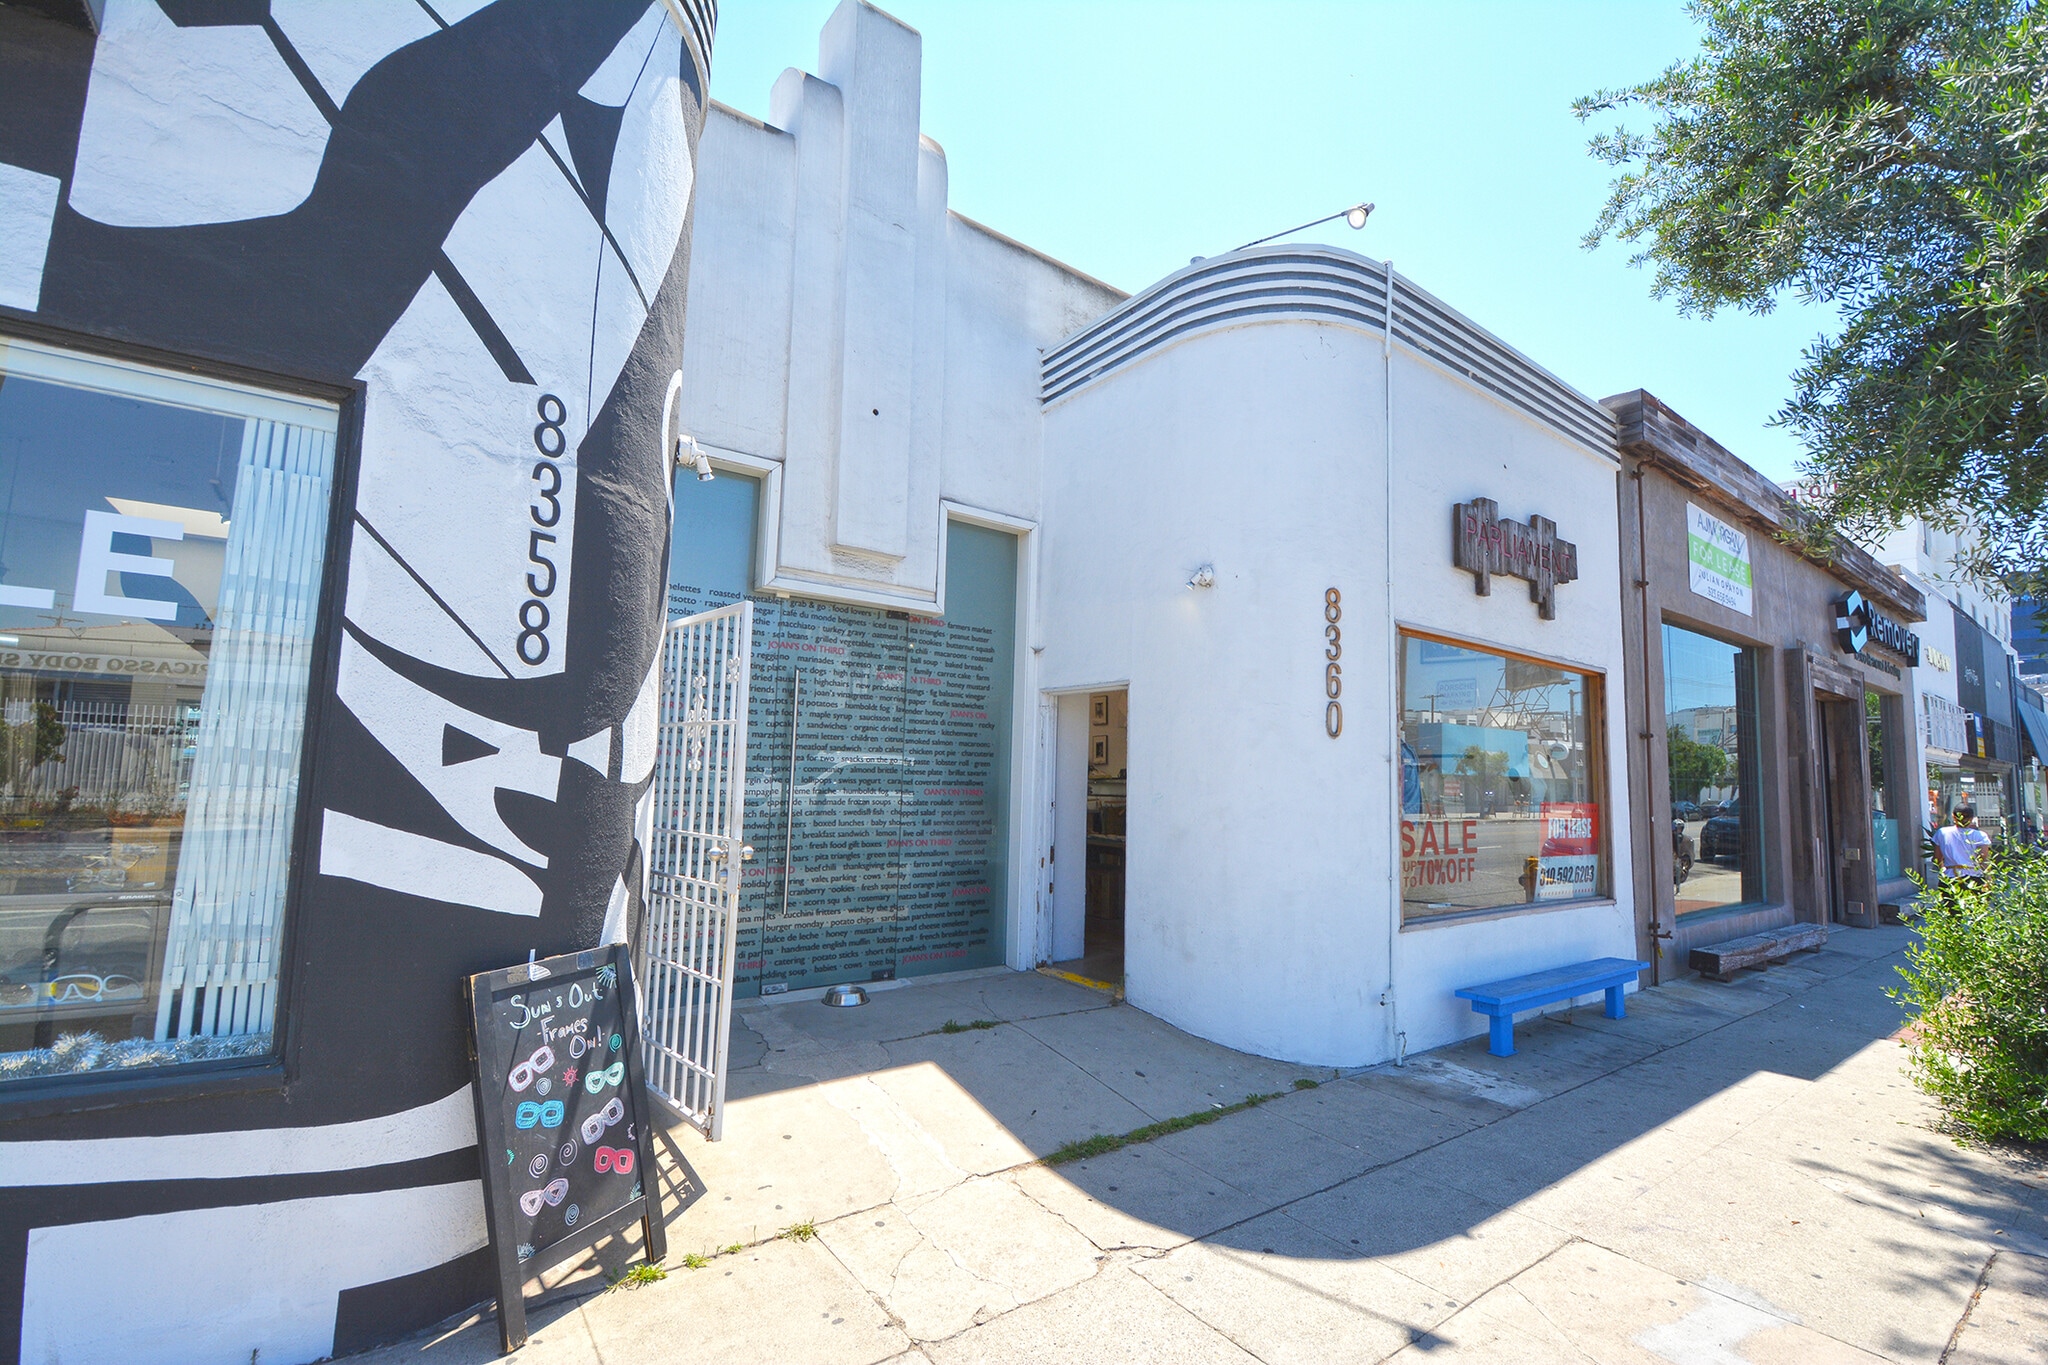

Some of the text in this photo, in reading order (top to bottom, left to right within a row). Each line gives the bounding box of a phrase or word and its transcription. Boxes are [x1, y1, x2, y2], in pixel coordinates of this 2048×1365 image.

[516, 393, 567, 667] 8358
[1466, 516, 1571, 576] PARLIAMENT
[1693, 541, 1747, 582] FOR LEASE
[669, 596, 696, 605] risotto
[709, 589, 740, 600] roasted
[832, 605, 849, 613] food
[850, 607, 872, 616] lovers
[811, 614, 837, 622] monde
[838, 617, 866, 627] beignets
[778, 620, 816, 630] macchiato
[822, 625, 846, 636] turkey
[848, 629, 865, 638] gravy
[788, 631, 874, 648] beans grilled vegetables
[820, 645, 844, 655] THIRD
[797, 655, 834, 664] marinades
[841, 660, 871, 669] espresso
[1325, 587, 1343, 739] 8360
[810, 666, 826, 675] dogs
[833, 669, 848, 678] high
[850, 671, 870, 679] chairs
[752, 674, 772, 682] dried
[814, 677, 849, 688] highchairs
[750, 684, 774, 693] friends
[814, 689, 835, 697] joan's
[837, 692, 873, 701] vinaigrette
[806, 701, 838, 710] potatoes
[845, 702, 878, 710] humboldt
[810, 711, 830, 721] maple
[833, 713, 852, 721] syrup
[807, 721, 847, 730] sandwiches
[821, 733, 844, 741] letters
[851, 734, 878, 742] children
[830, 744, 861, 752] sandwich
[752, 753, 790, 762] afternoon
[806, 753, 816, 761] for
[803, 766, 843, 774] community
[801, 777, 832, 785] lollipops
[802, 831, 835, 839] breakfast
[838, 830, 869, 838] sandwich
[1548, 818, 1592, 839] FOR LEASE
[1401, 820, 1478, 858] SALE
[793, 854, 808, 862] bars
[815, 854, 828, 862] pita
[831, 853, 860, 862] triangles
[805, 864, 821, 872] beef
[822, 863, 836, 871] chili
[1403, 861, 1416, 872] UP
[831, 874, 856, 884] parking
[1403, 876, 1417, 888] TO
[789, 888, 825, 896] cranberry
[804, 898, 825, 906] acorn
[784, 906, 874, 919] zucchini fritters by
[766, 916, 874, 932] burger monday potato chips
[799, 932, 819, 940] leche
[826, 930, 848, 938] honey
[781, 938, 870, 954] handmade english muffin
[774, 950, 858, 966] catering potato sticks
[789, 968, 807, 977] soup
[814, 964, 837, 973] babies
[509, 982, 604, 1029] Sun's Out
[540, 1015, 588, 1046] Frames
